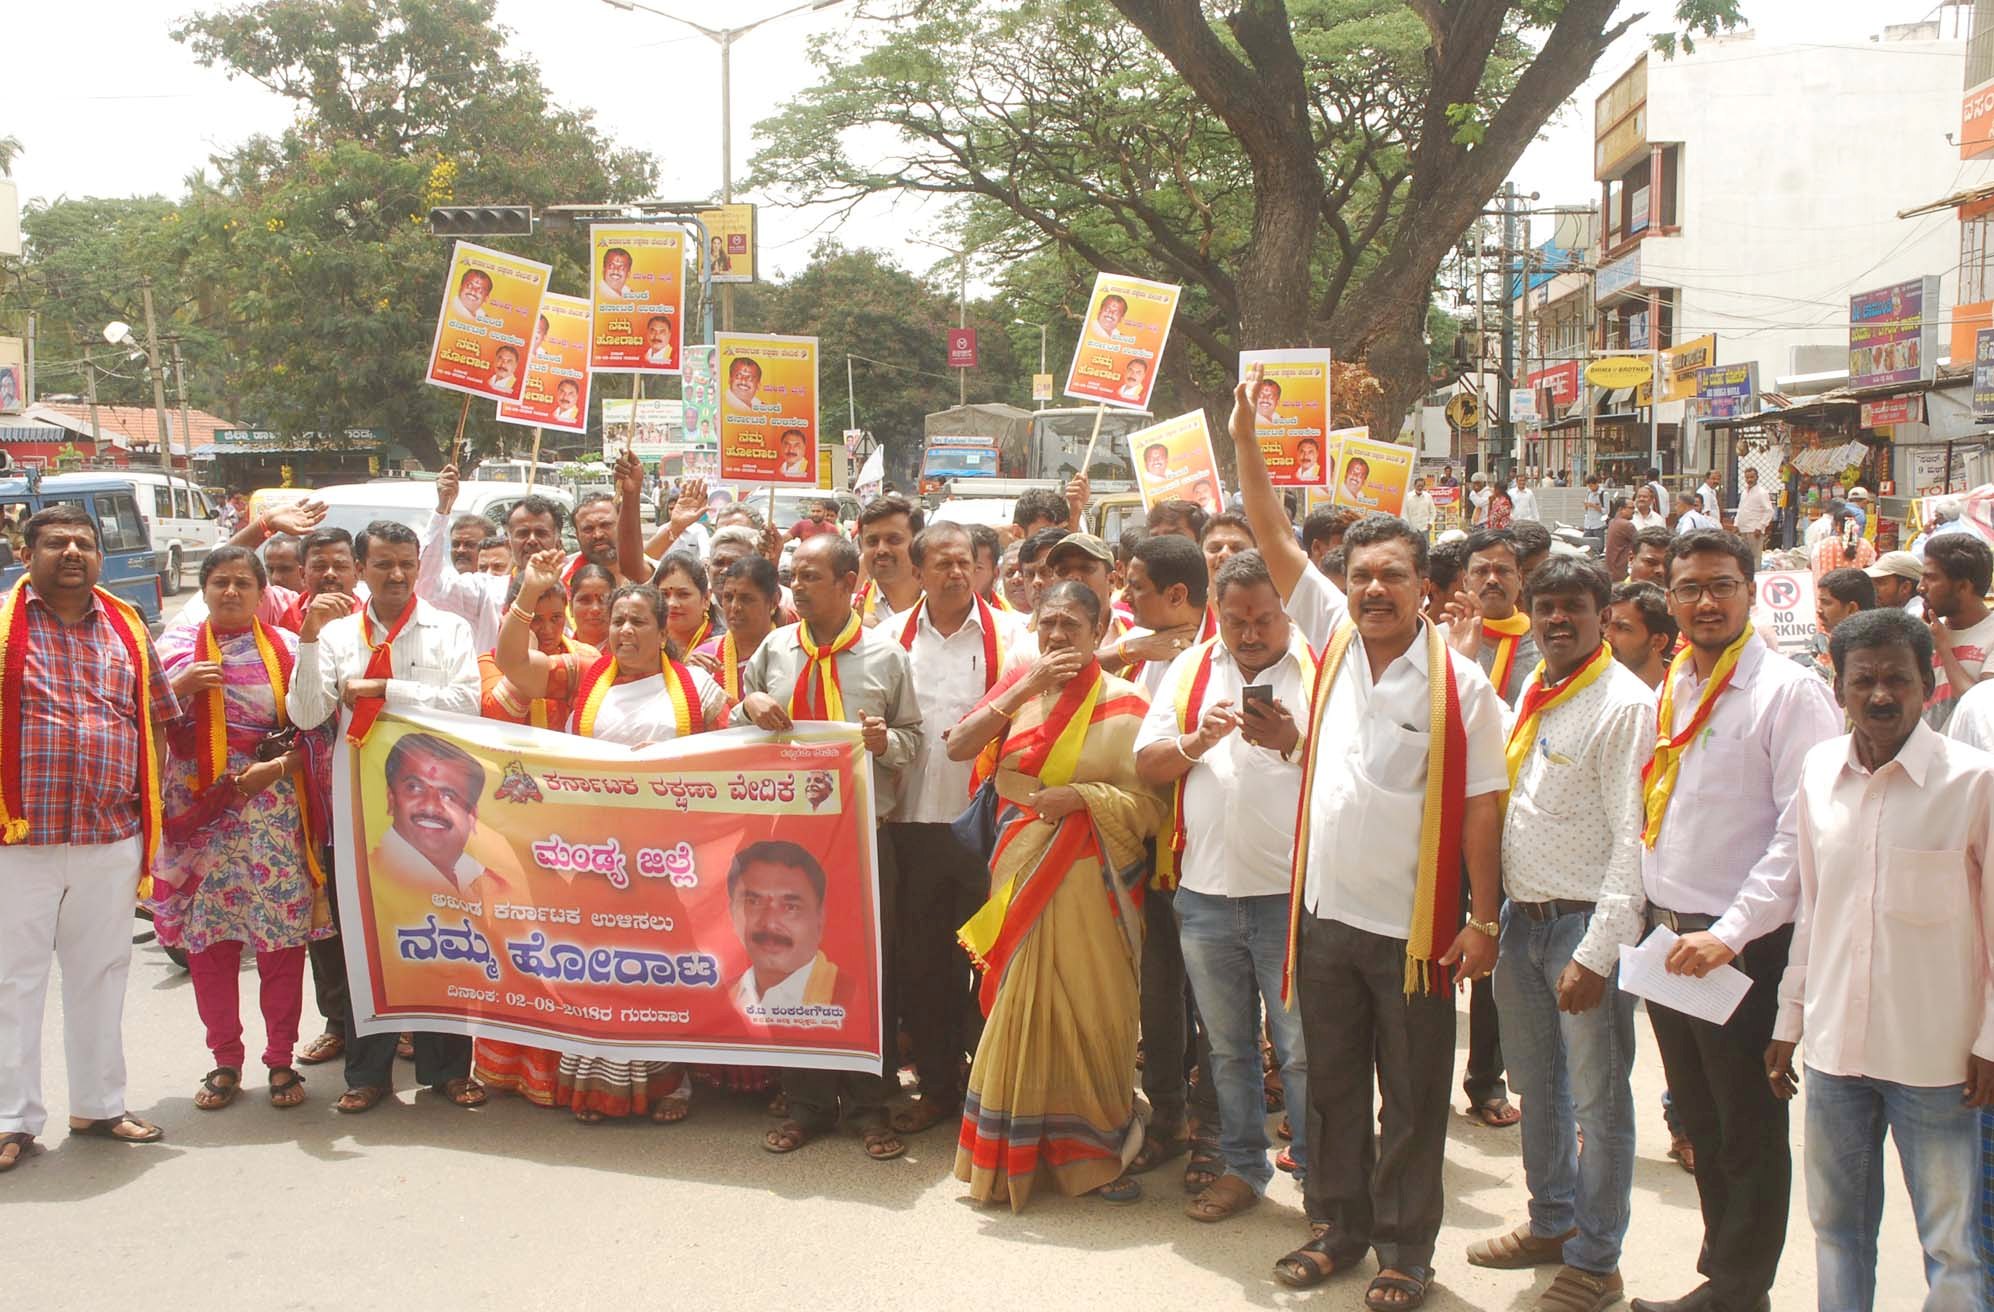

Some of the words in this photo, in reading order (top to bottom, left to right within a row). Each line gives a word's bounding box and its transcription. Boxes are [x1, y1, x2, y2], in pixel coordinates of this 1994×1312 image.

[1773, 623, 1816, 636] RKING
[1774, 611, 1794, 623] NO
[542, 770, 640, 795] ಕರ್ನಾಟಕ
[648, 775, 718, 812] ರಕ್ಷಣಾ
[727, 773, 796, 803] ವೇದಿಕೆ
[533, 836, 627, 887] ಮಂಡ್ಯ
[638, 843, 696, 886] ಜಿಲ್ಲೆ
[493, 900, 582, 925] ಕರ್ನಾಟಕ
[590, 911, 674, 932] ಉಳಿಸಲು
[397, 914, 500, 980] ನಮ್ಮ
[506, 931, 718, 986] ಹೋರಾಟ
[447, 984, 501, 1004] ದಿನಾಂಕ:
[620, 1007, 690, 1024] ಗುರುವಾರ
